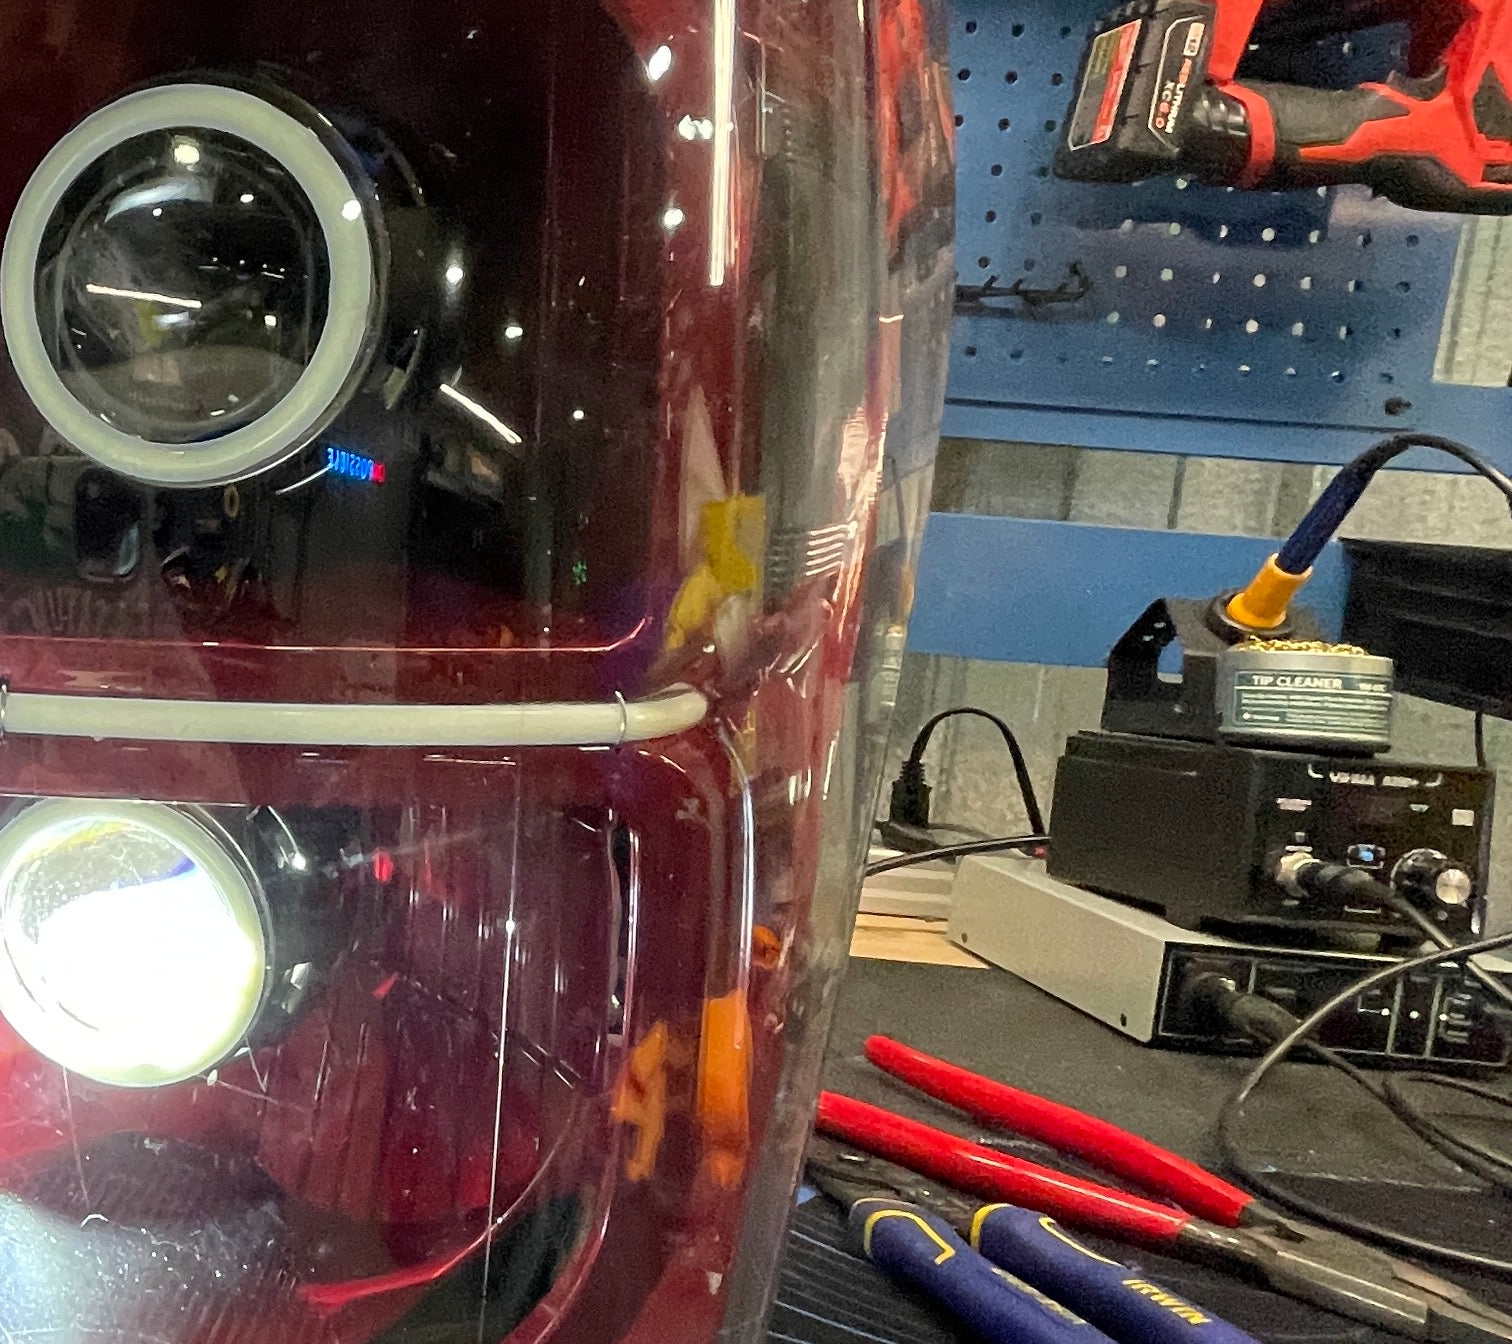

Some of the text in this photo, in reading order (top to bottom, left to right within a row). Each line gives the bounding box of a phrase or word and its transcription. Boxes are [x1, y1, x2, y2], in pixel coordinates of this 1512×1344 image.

[1252, 674, 1274, 686] TIP
[1276, 676, 1343, 690] CLEANER
[1121, 1279, 1213, 1325] IRWIN
